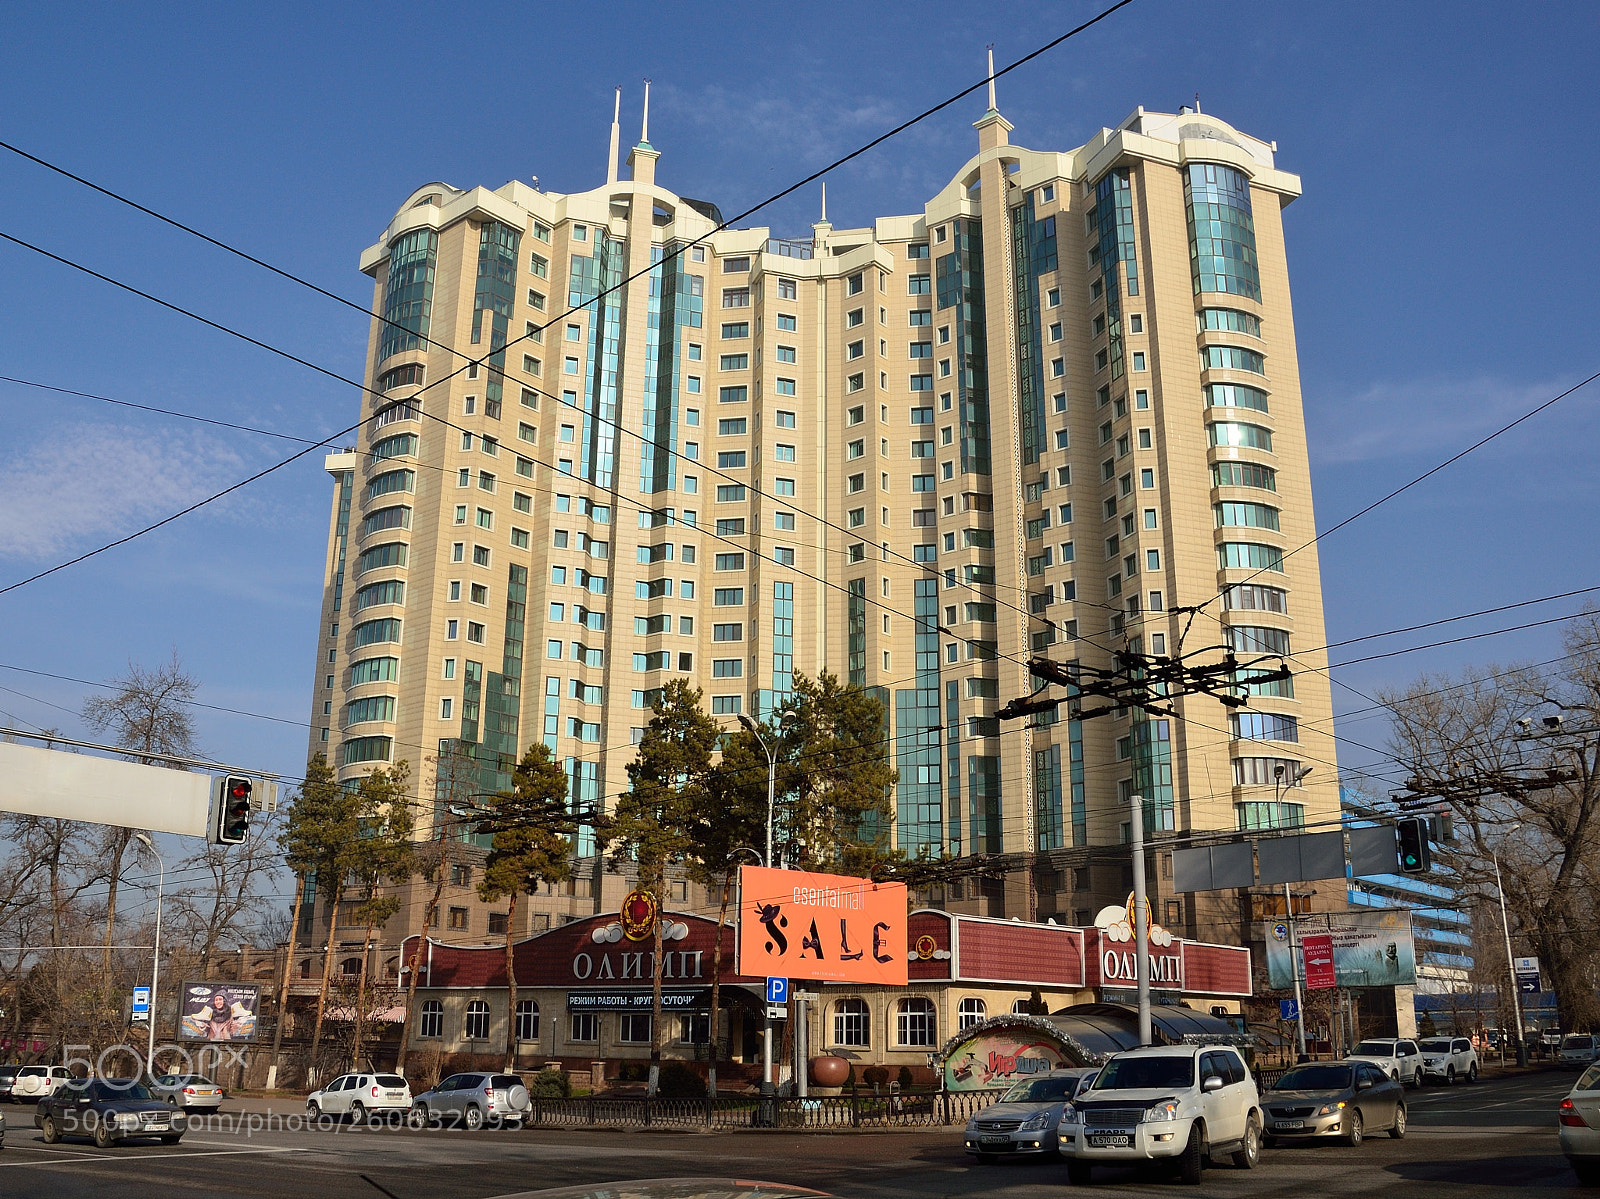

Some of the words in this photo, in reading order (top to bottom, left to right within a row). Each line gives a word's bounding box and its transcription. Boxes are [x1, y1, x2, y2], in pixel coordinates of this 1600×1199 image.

[757, 903, 894, 963] SALE
[573, 950, 703, 980] ОЛИМП
[569, 996, 596, 1005] РЕЖИМ
[598, 996, 628, 1005] РАБОТЫ
[772, 980, 784, 999] P
